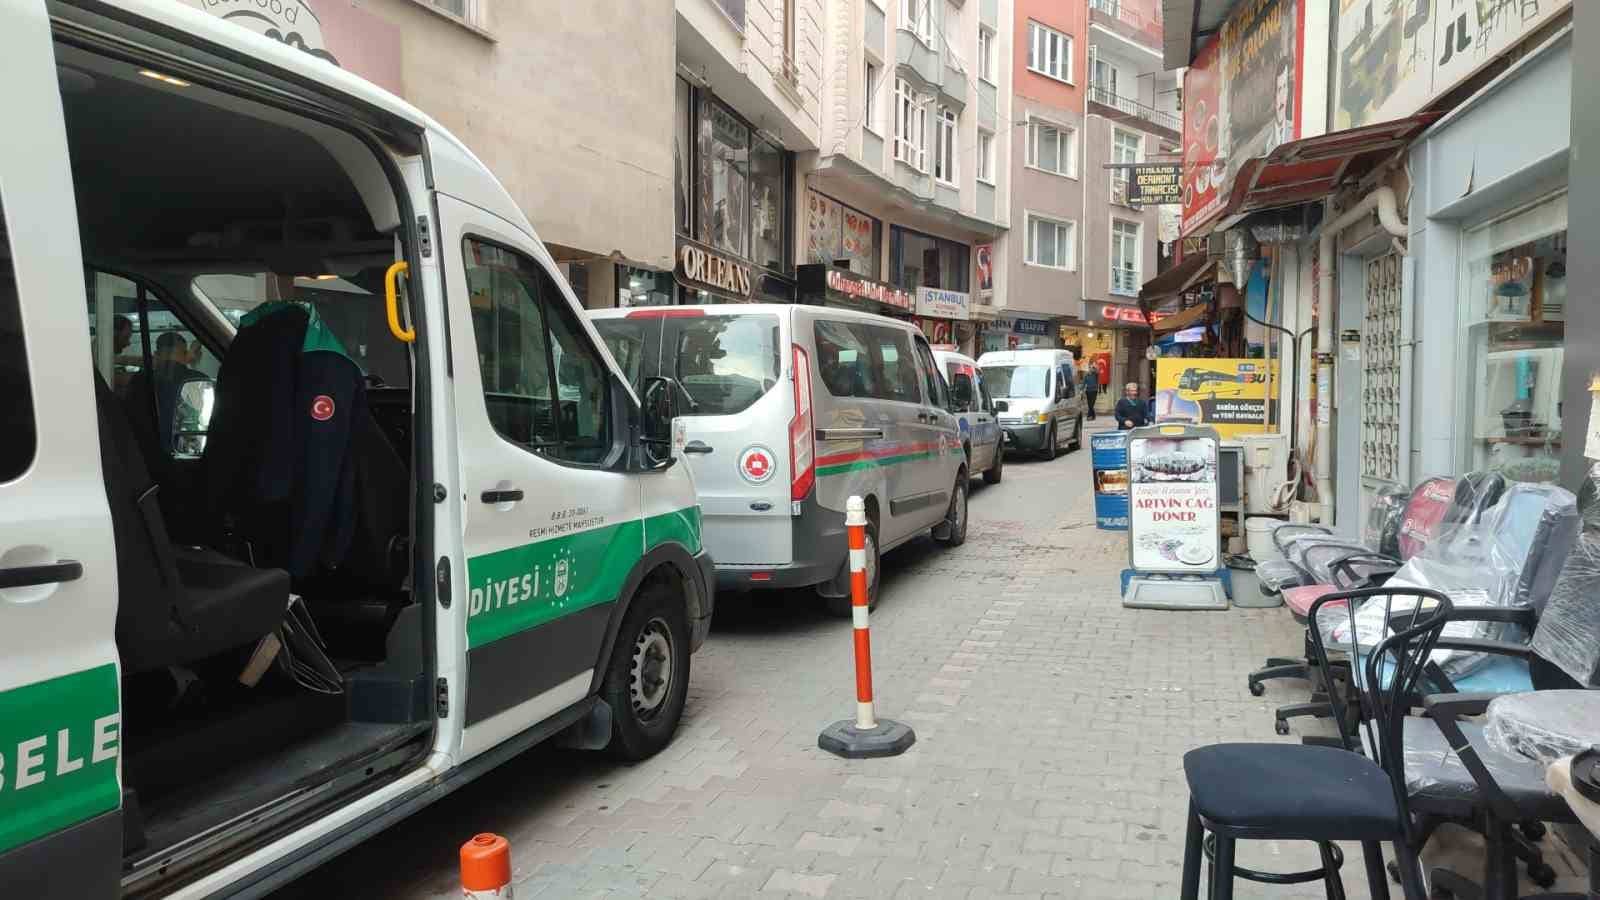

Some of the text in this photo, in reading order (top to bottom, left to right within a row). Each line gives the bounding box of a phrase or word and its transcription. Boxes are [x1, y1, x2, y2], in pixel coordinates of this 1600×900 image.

[683, 245, 751, 297] ORLEANS
[470, 564, 540, 617] DİYESİ
[0, 712, 121, 792] ELE
